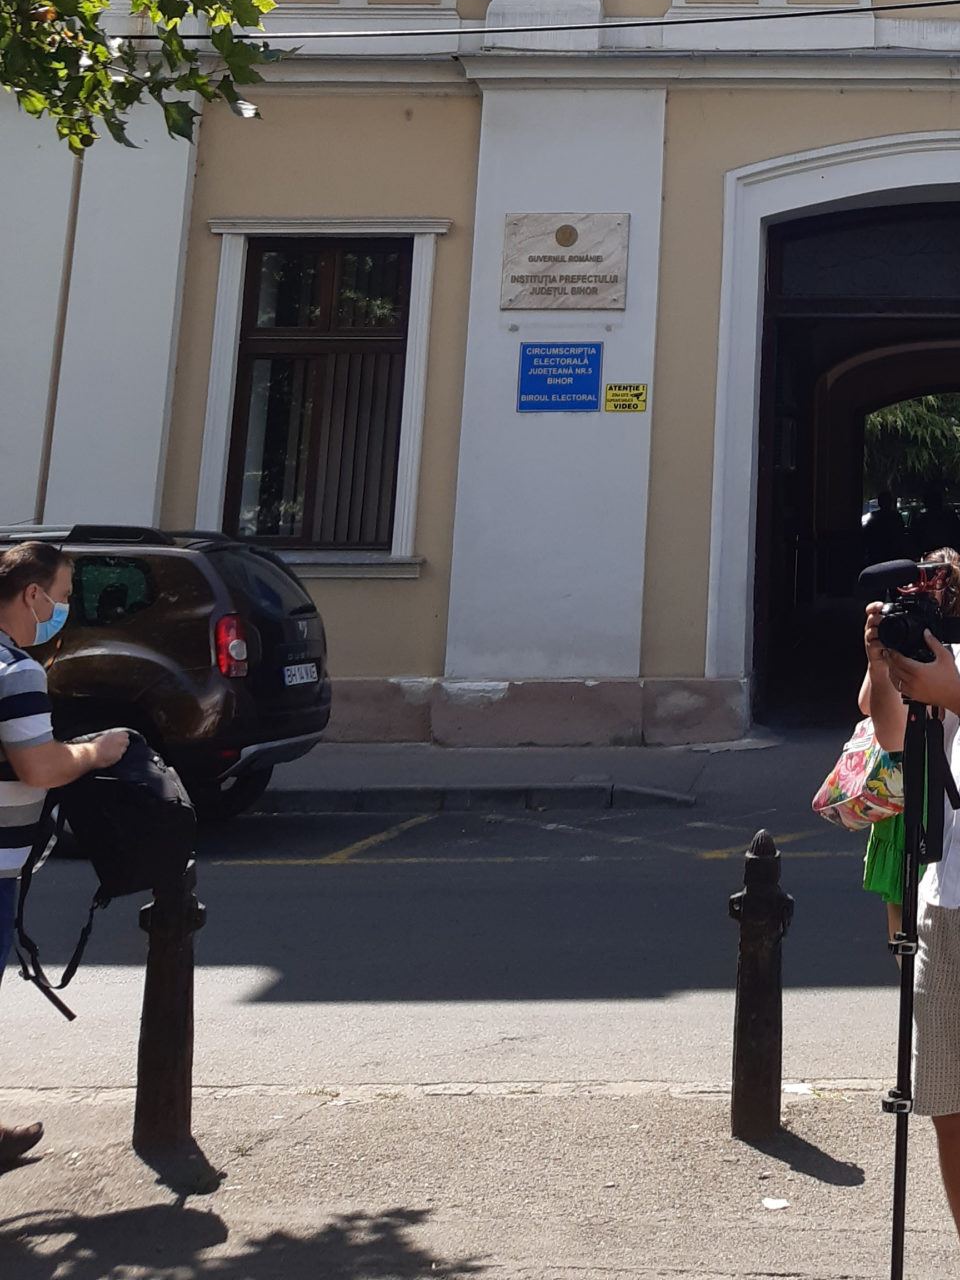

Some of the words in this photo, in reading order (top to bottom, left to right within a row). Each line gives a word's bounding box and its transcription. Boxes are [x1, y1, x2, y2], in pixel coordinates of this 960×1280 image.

[528, 255, 566, 263] GUVERNUL
[568, 254, 603, 263] ROMÂNIEI
[559, 274, 618, 284] PREFECTULUI
[570, 286, 599, 295] BIHOR
[546, 377, 574, 385] BIHOR
[520, 394, 550, 402] BIROUL
[551, 394, 598, 402] ELECTORAL
